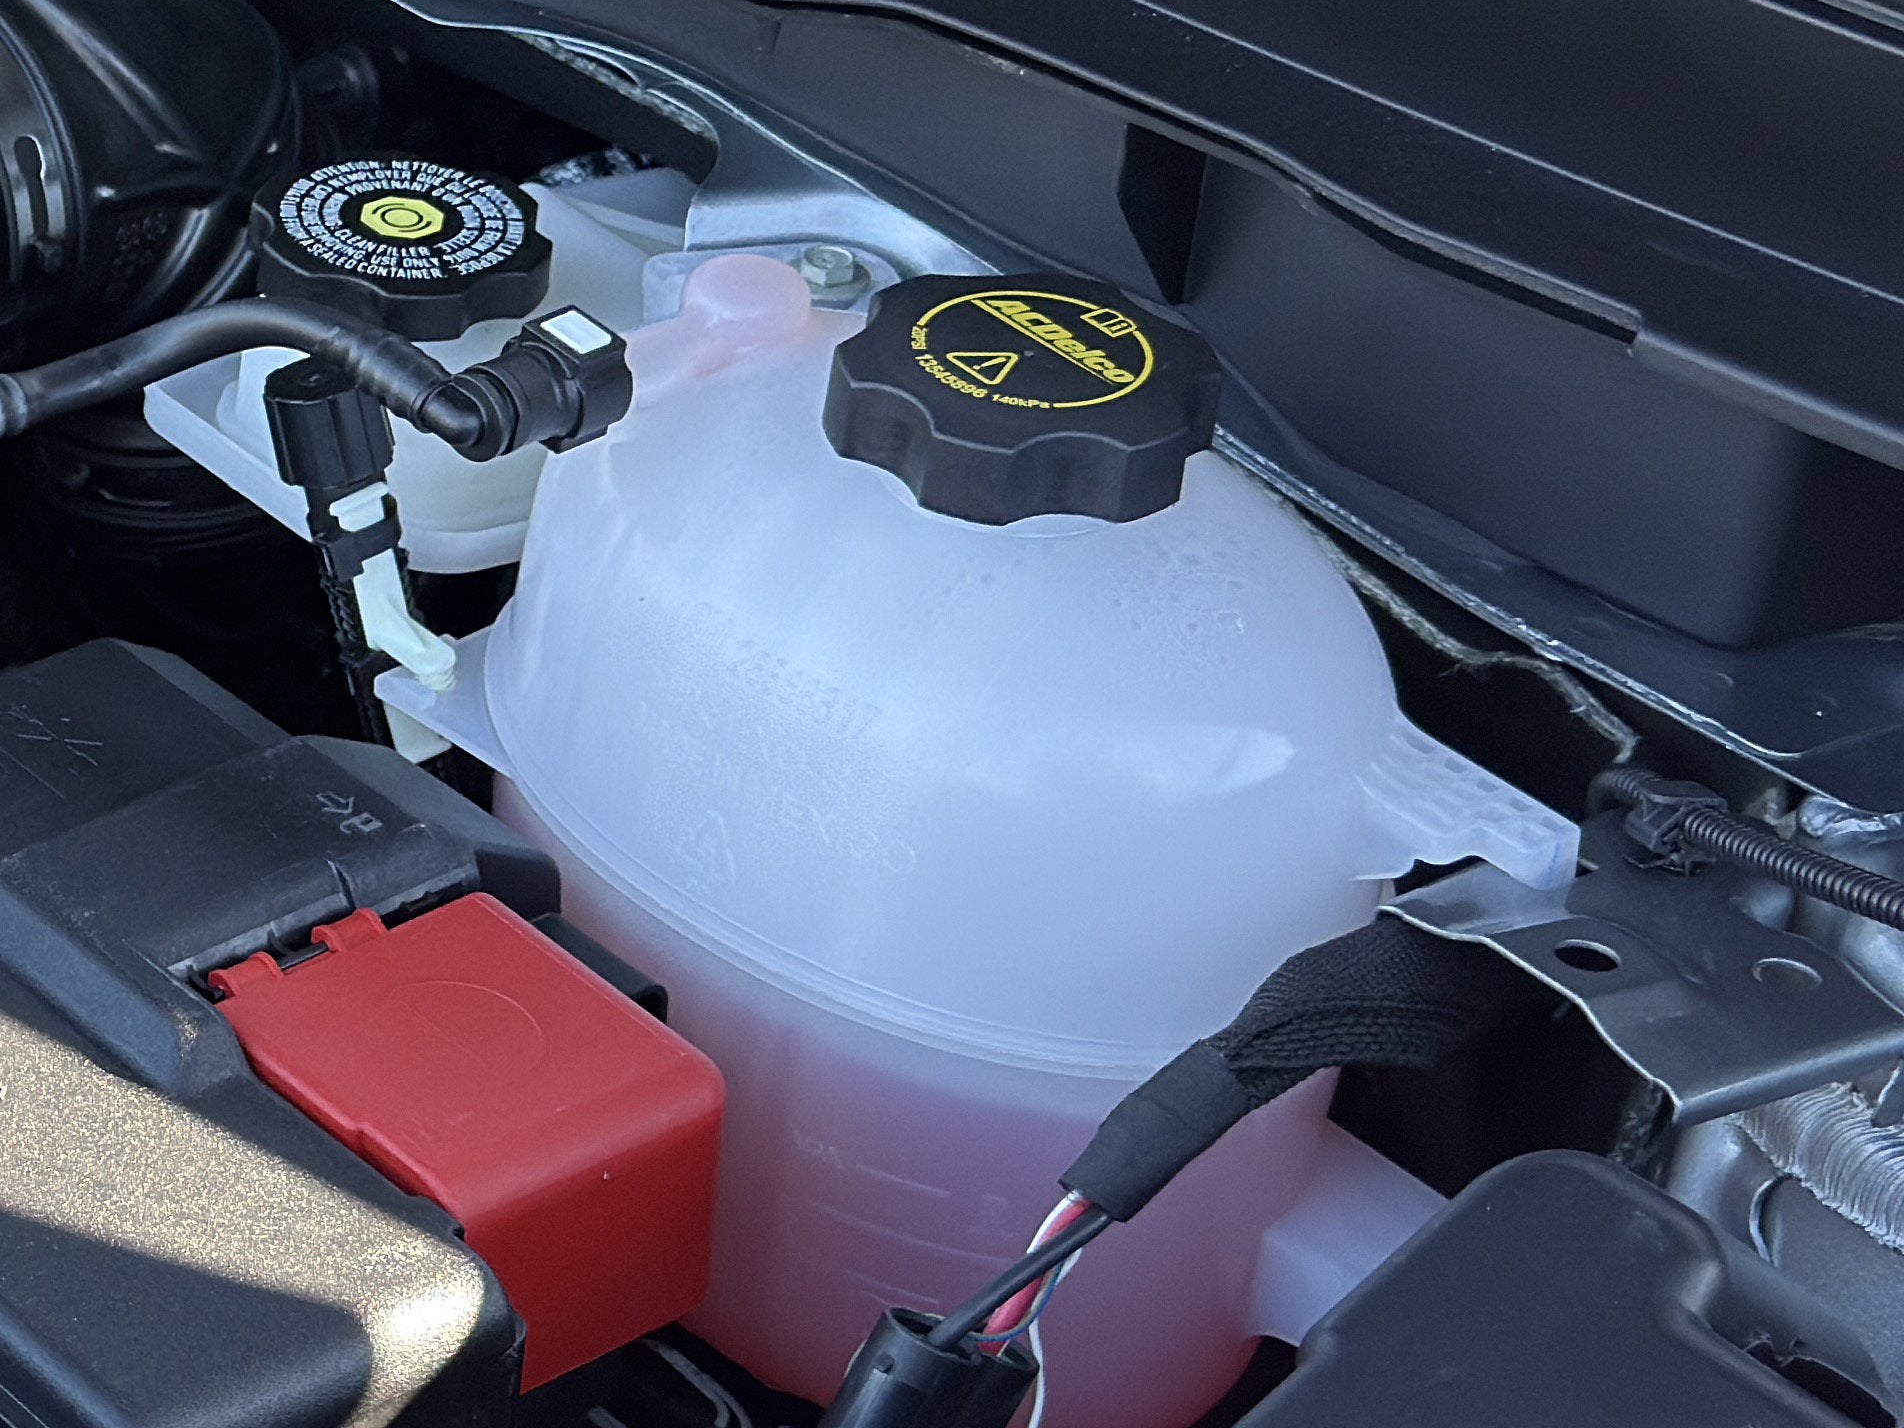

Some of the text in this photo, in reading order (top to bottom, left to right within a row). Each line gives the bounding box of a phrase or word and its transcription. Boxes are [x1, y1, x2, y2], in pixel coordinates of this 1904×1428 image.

[334, 229, 378, 253] CLEAN
[376, 244, 431, 257] FILLER
[307, 243, 358, 270] SEALED
[357, 263, 448, 281] CONTAINER.
[371, 255, 399, 267] USE
[402, 257, 440, 268] ONLY
[986, 300, 1136, 383] ACDelco
